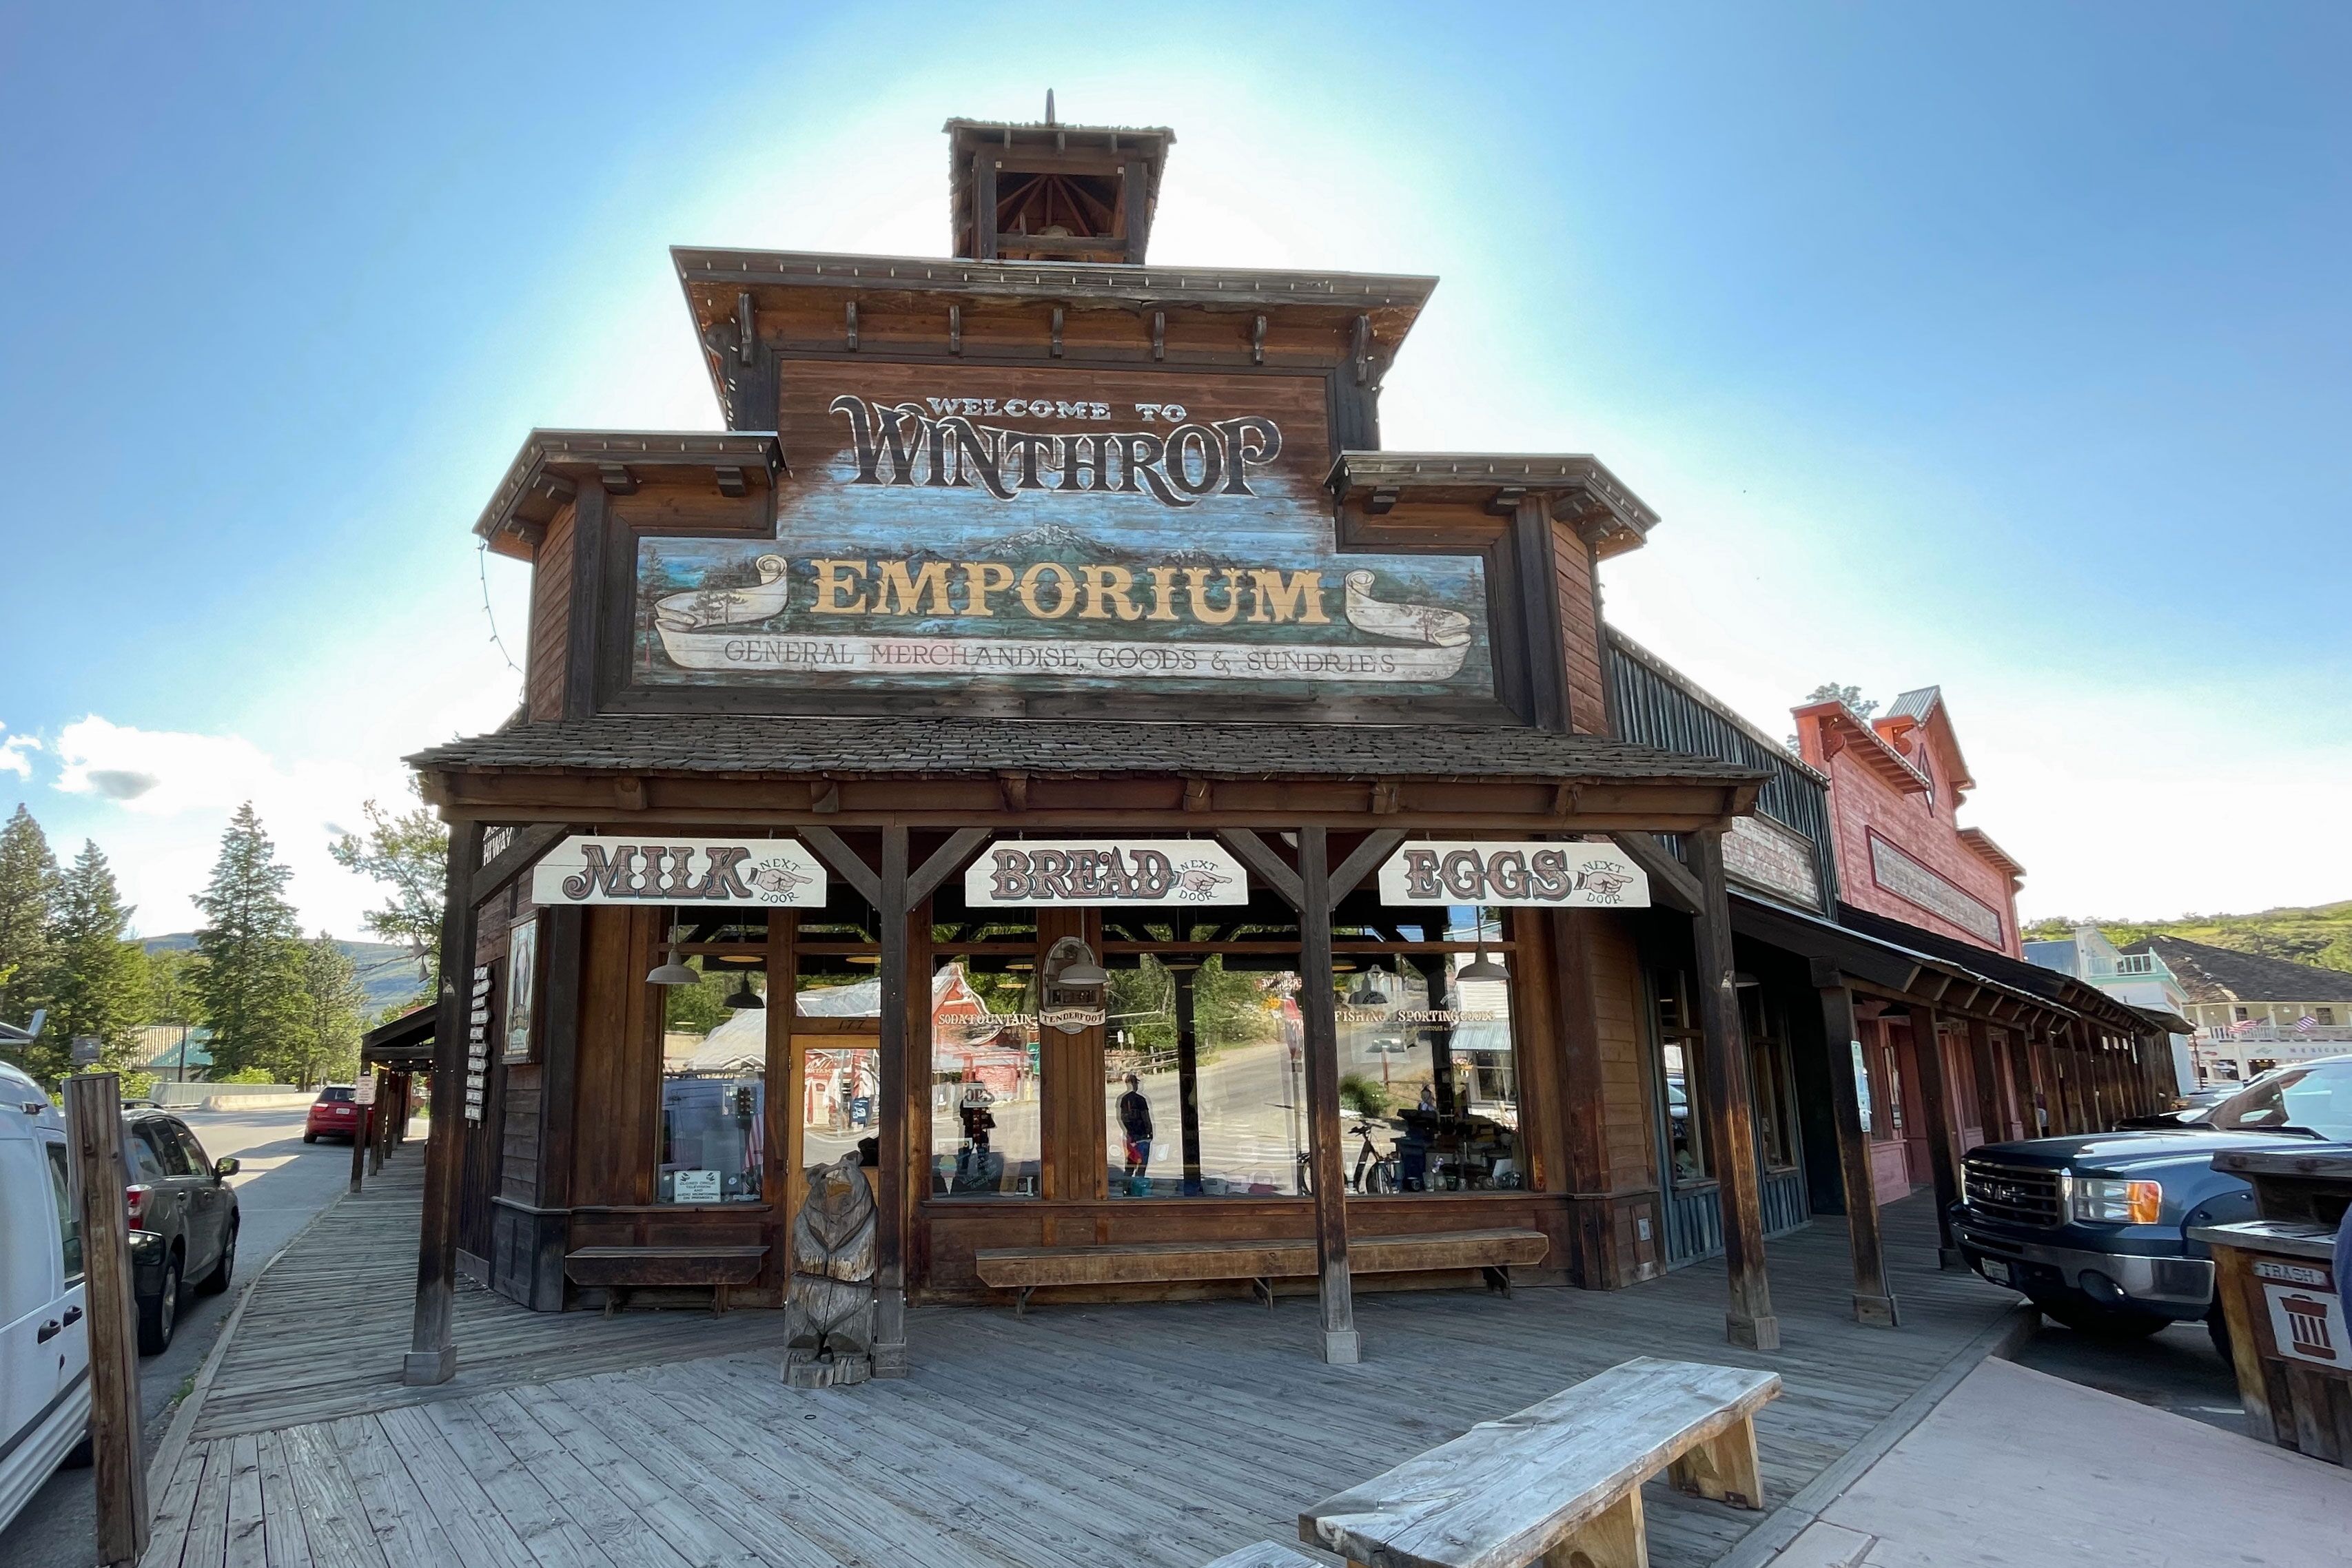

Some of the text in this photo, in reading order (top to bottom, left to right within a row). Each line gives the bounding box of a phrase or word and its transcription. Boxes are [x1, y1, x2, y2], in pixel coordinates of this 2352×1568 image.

[927, 397, 1187, 422] WELCOME TO
[830, 395, 1282, 508] WINTHROP
[809, 558, 1330, 623] EMPORIUM
[725, 640, 1395, 674] GENERAL MERCHANDISE, GOODS & SUNDRIES
[483, 827, 513, 866] HIWAY
[562, 845, 753, 900] MILK
[759, 858, 801, 873] NEXT
[1180, 860, 1218, 872] NEXT
[1582, 860, 1625, 874] NEXT
[990, 846, 1173, 901] BREAD
[1404, 848, 1572, 901] EGGS
[760, 891, 800, 904] DOOR
[1179, 890, 1218, 902] DOOR
[1586, 894, 1624, 905] DOOR
[939, 1013, 1032, 1026] SODA FOUNTAIN
[1041, 1011, 1103, 1023] TENDERFOOT
[1333, 1010, 1495, 1022] FISHING SPORTING GOODS
[838, 1020, 866, 1030] 177
[2260, 1263, 2315, 1283] TRASH
